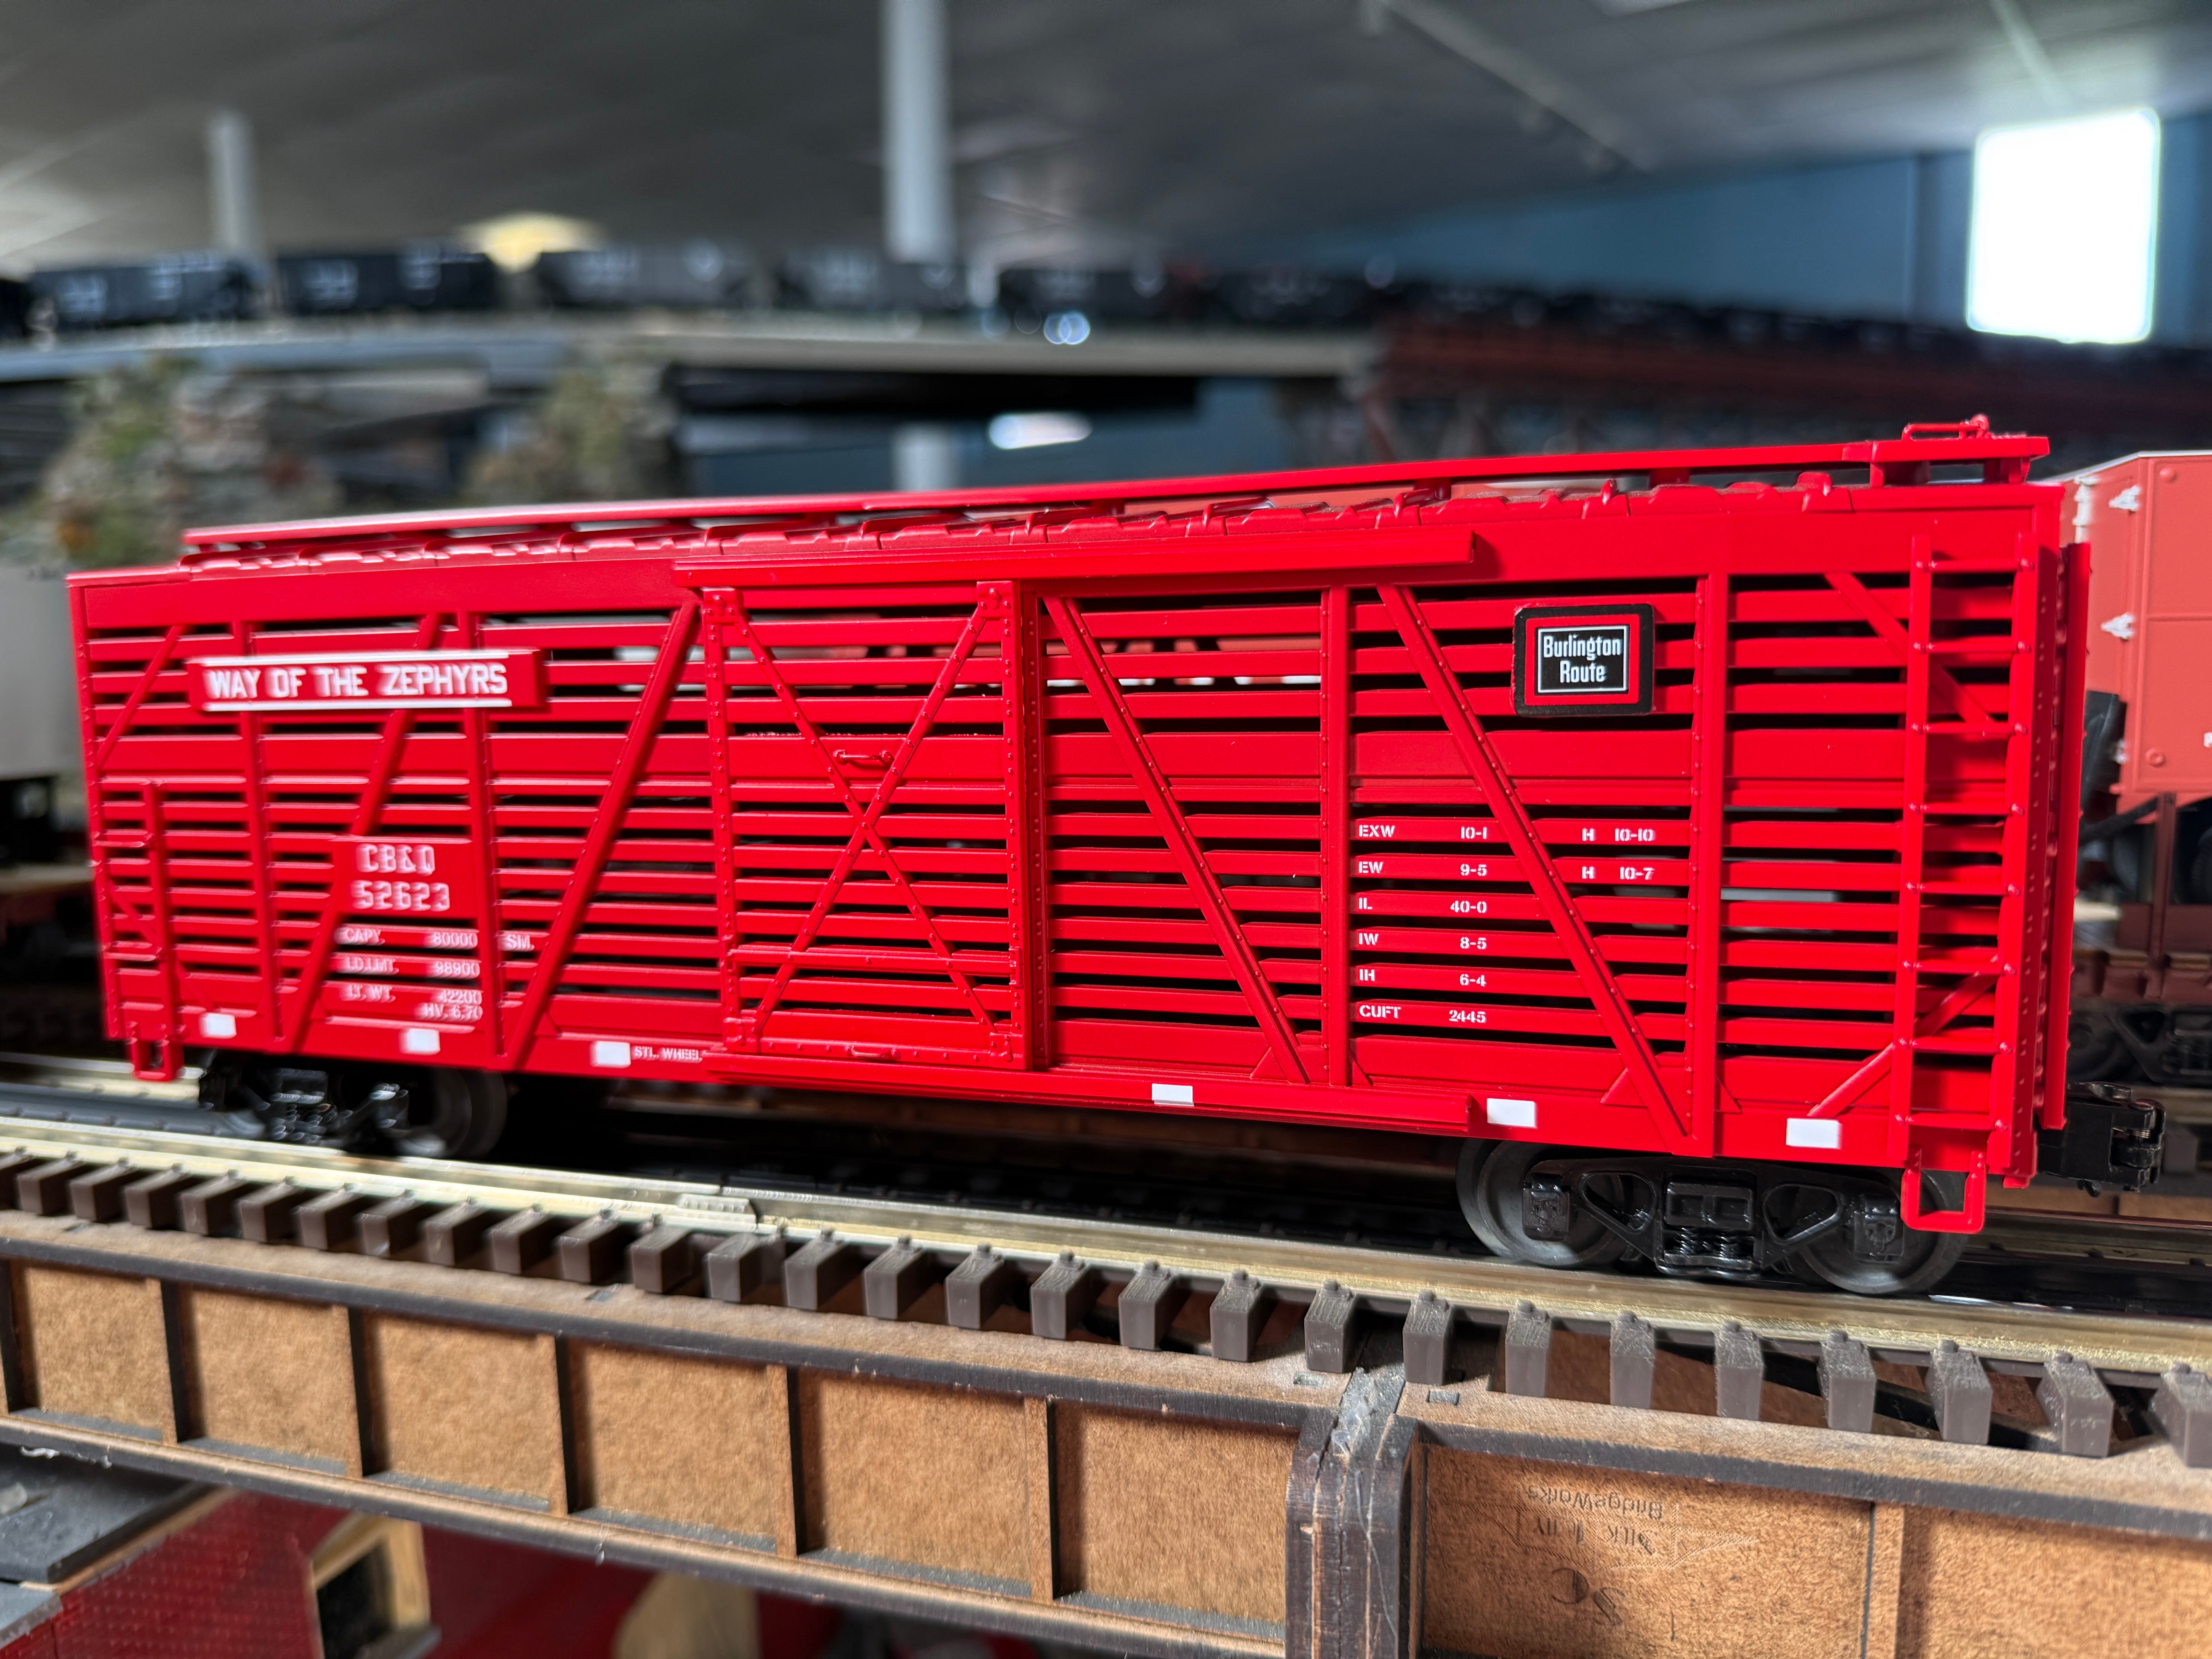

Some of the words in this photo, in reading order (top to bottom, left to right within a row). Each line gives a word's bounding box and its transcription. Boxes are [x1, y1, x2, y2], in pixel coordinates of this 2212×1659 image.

[1543, 634, 1622, 661] Burlington
[1560, 660, 1607, 683] Route
[204, 669, 261, 698] WAY
[266, 667, 306, 697] OF
[313, 665, 369, 697] THE
[376, 663, 508, 696] ZEPHYRS
[1358, 824, 1395, 838] EXW
[1460, 826, 1487, 839] 10-1
[1582, 828, 1595, 842] H
[1614, 828, 1654, 842] 10-10
[356, 843, 435, 875] CB&Q
[1358, 861, 1384, 874] EW
[1460, 864, 1487, 876] 9-5
[1582, 866, 1595, 879] H
[1620, 867, 1654, 880] 10-7
[351, 880, 450, 911] 52623
[1358, 897, 1373, 910] IL
[1450, 900, 1487, 913] 40-0
[427, 932, 478, 949] 80000
[1358, 933, 1379, 945] IW
[1460, 937, 1487, 950] 8-5
[431, 961, 480, 979] 98900
[1359, 969, 1375, 981] IH
[1460, 974, 1487, 987] 6-4
[435, 989, 482, 1006] 42200
[1359, 1005, 1401, 1018] CUFT
[1449, 1010, 1487, 1023] 2445
